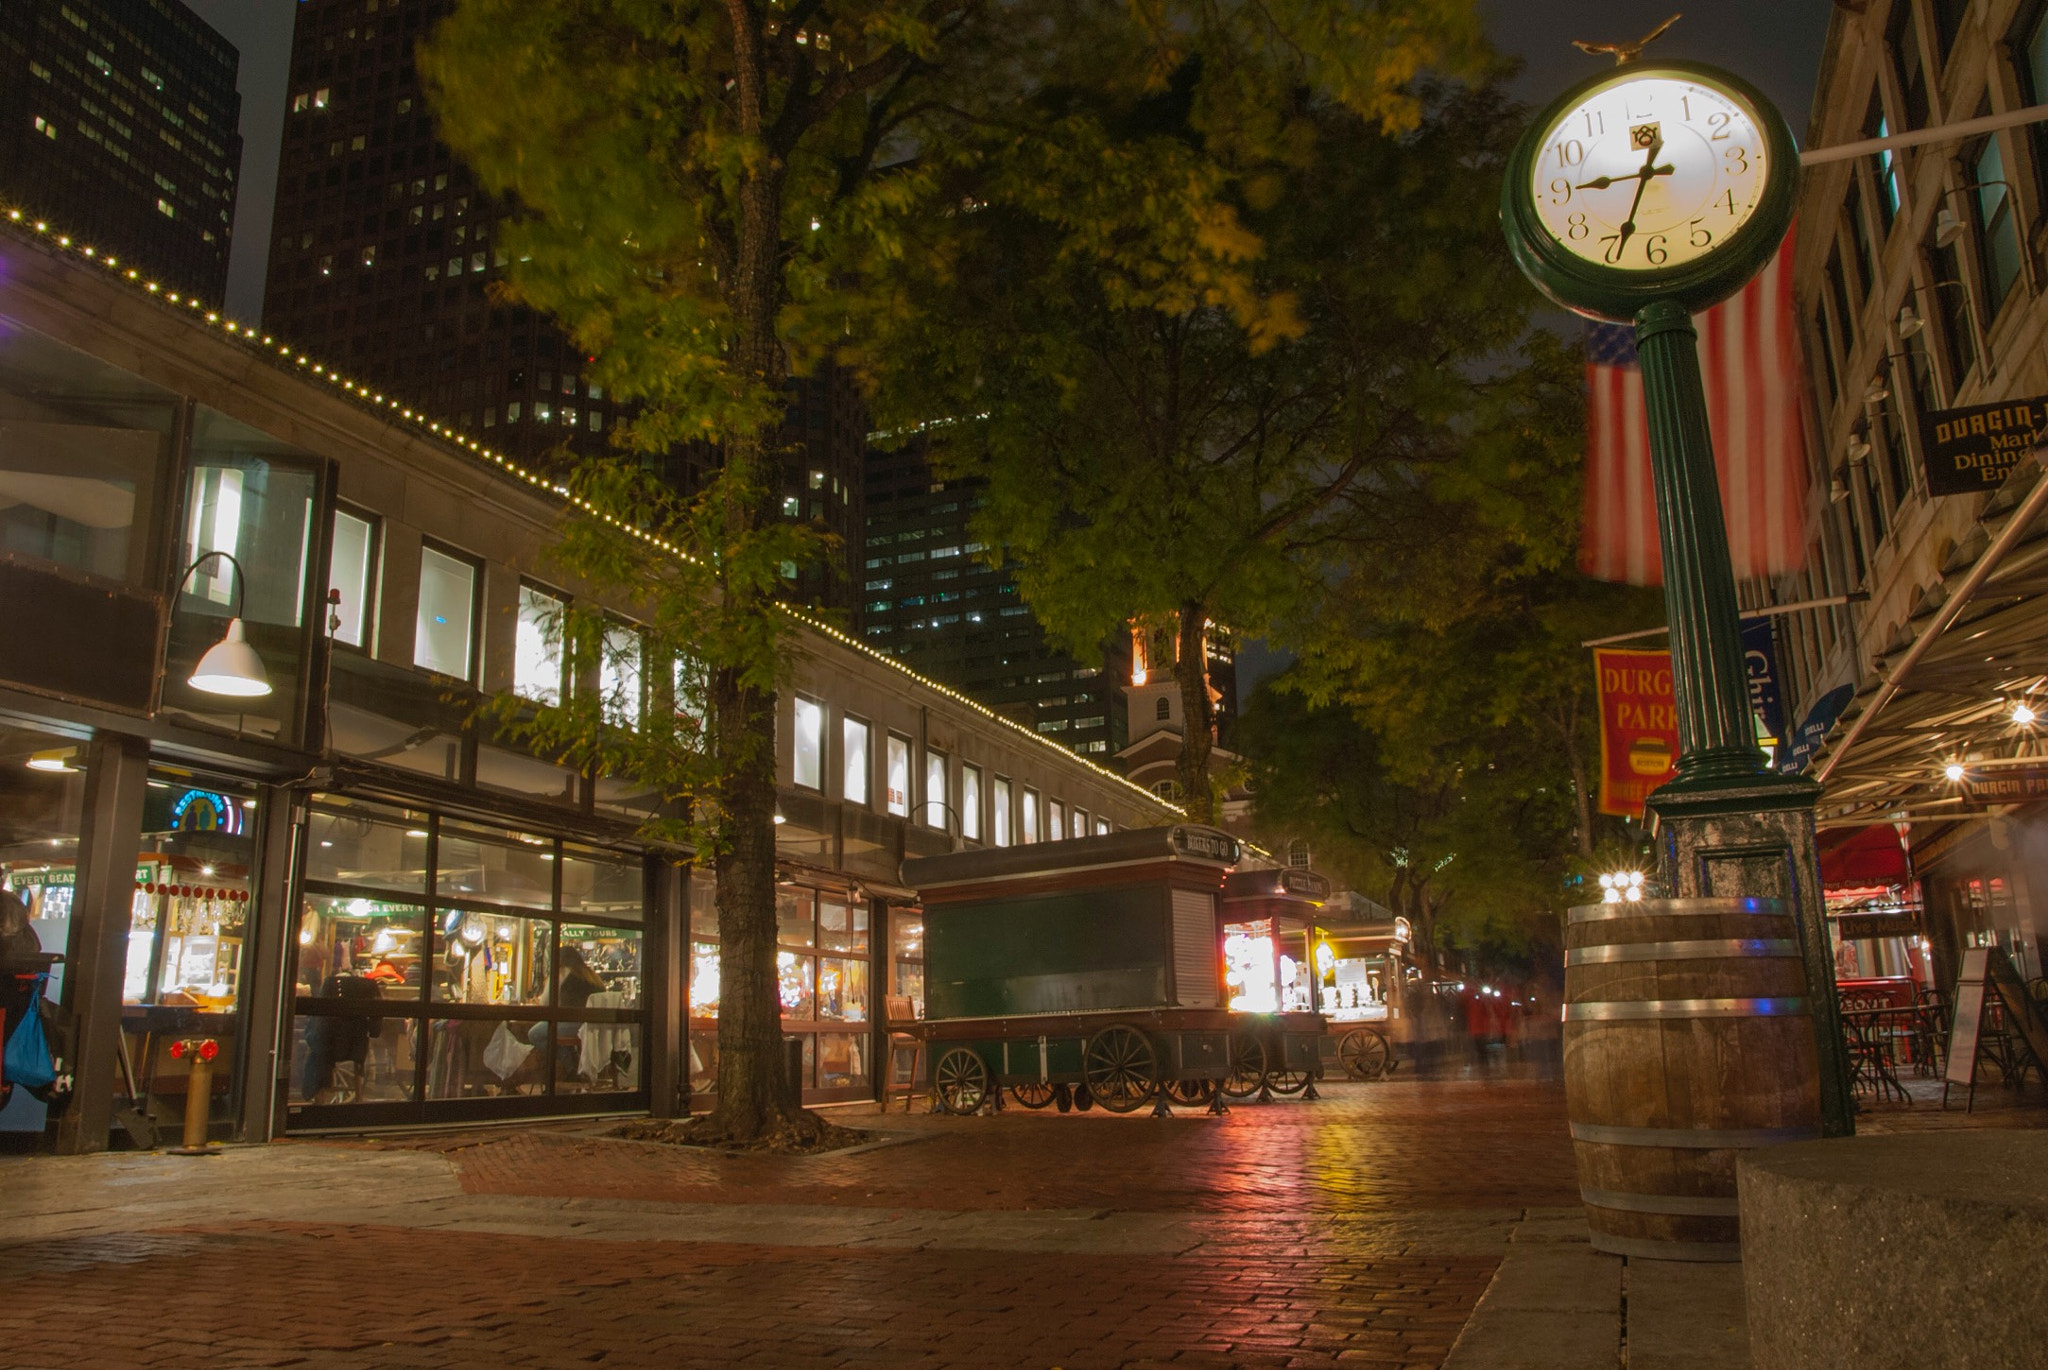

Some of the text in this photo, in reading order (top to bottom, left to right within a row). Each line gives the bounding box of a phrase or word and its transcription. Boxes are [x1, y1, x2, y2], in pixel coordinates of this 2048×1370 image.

[1681, 95, 1691, 122] 1
[1584, 110, 1604, 137] 11
[1707, 111, 1730, 142] 2
[1556, 139, 1583, 168] 10
[1725, 147, 1748, 175] 3
[1550, 177, 1572, 205] 9
[1713, 188, 1739, 215] 4
[1567, 212, 1589, 240] 8
[1689, 217, 1712, 247] 5
[1598, 234, 1624, 264] 7
[1646, 235, 1668, 264] 6
[14, 875, 46, 886] EVERY
[382, 904, 413, 912] EVERY
